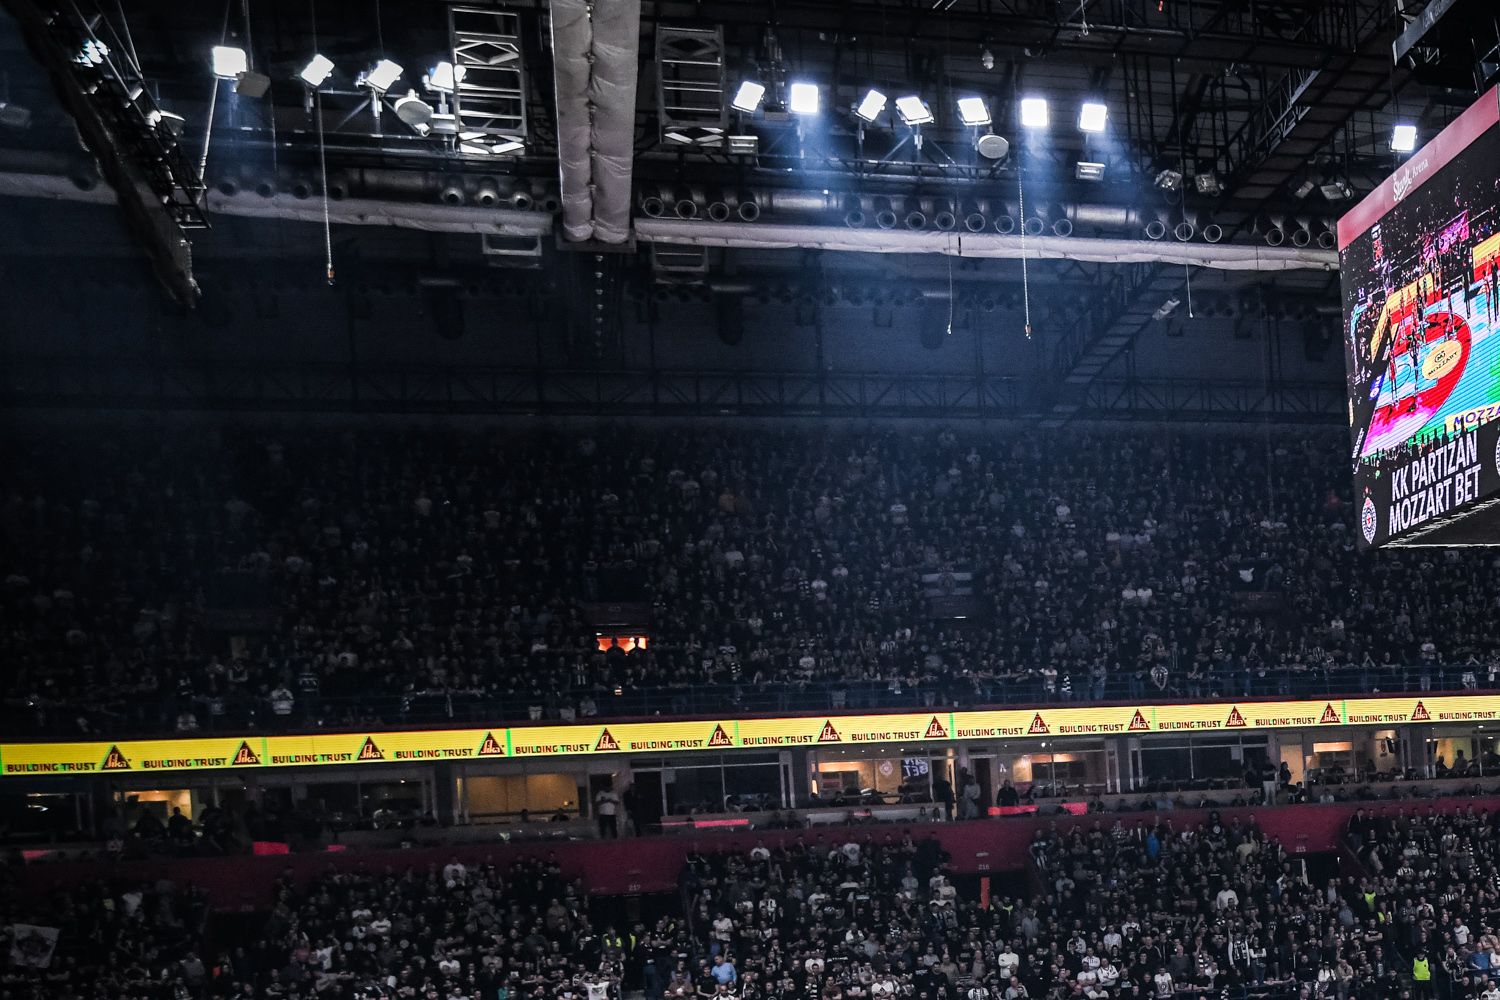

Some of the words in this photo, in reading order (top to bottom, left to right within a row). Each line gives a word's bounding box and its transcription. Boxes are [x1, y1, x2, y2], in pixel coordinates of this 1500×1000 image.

[1412, 158, 1429, 179] Arena
[1391, 465, 1409, 501] KK
[1411, 429, 1478, 492] PARTIZAN
[1389, 477, 1452, 536] MOZZART
[1455, 464, 1482, 507] BET
[1349, 714, 1382, 723] BUILDING
[1384, 713, 1408, 722] TRUST
[1060, 724, 1096, 733] BUILDING
[1099, 723, 1124, 732] TRUST
[743, 736, 783, 746] BUILDING
[786, 734, 813, 744] TRUST
[516, 745, 558, 755] BUILDING
[561, 744, 590, 753] TRUST
[272, 753, 318, 764] BUILDING
[321, 752, 352, 763] TRUST
[7, 762, 57, 773] BUILDING
[61, 761, 96, 772] TRUST
